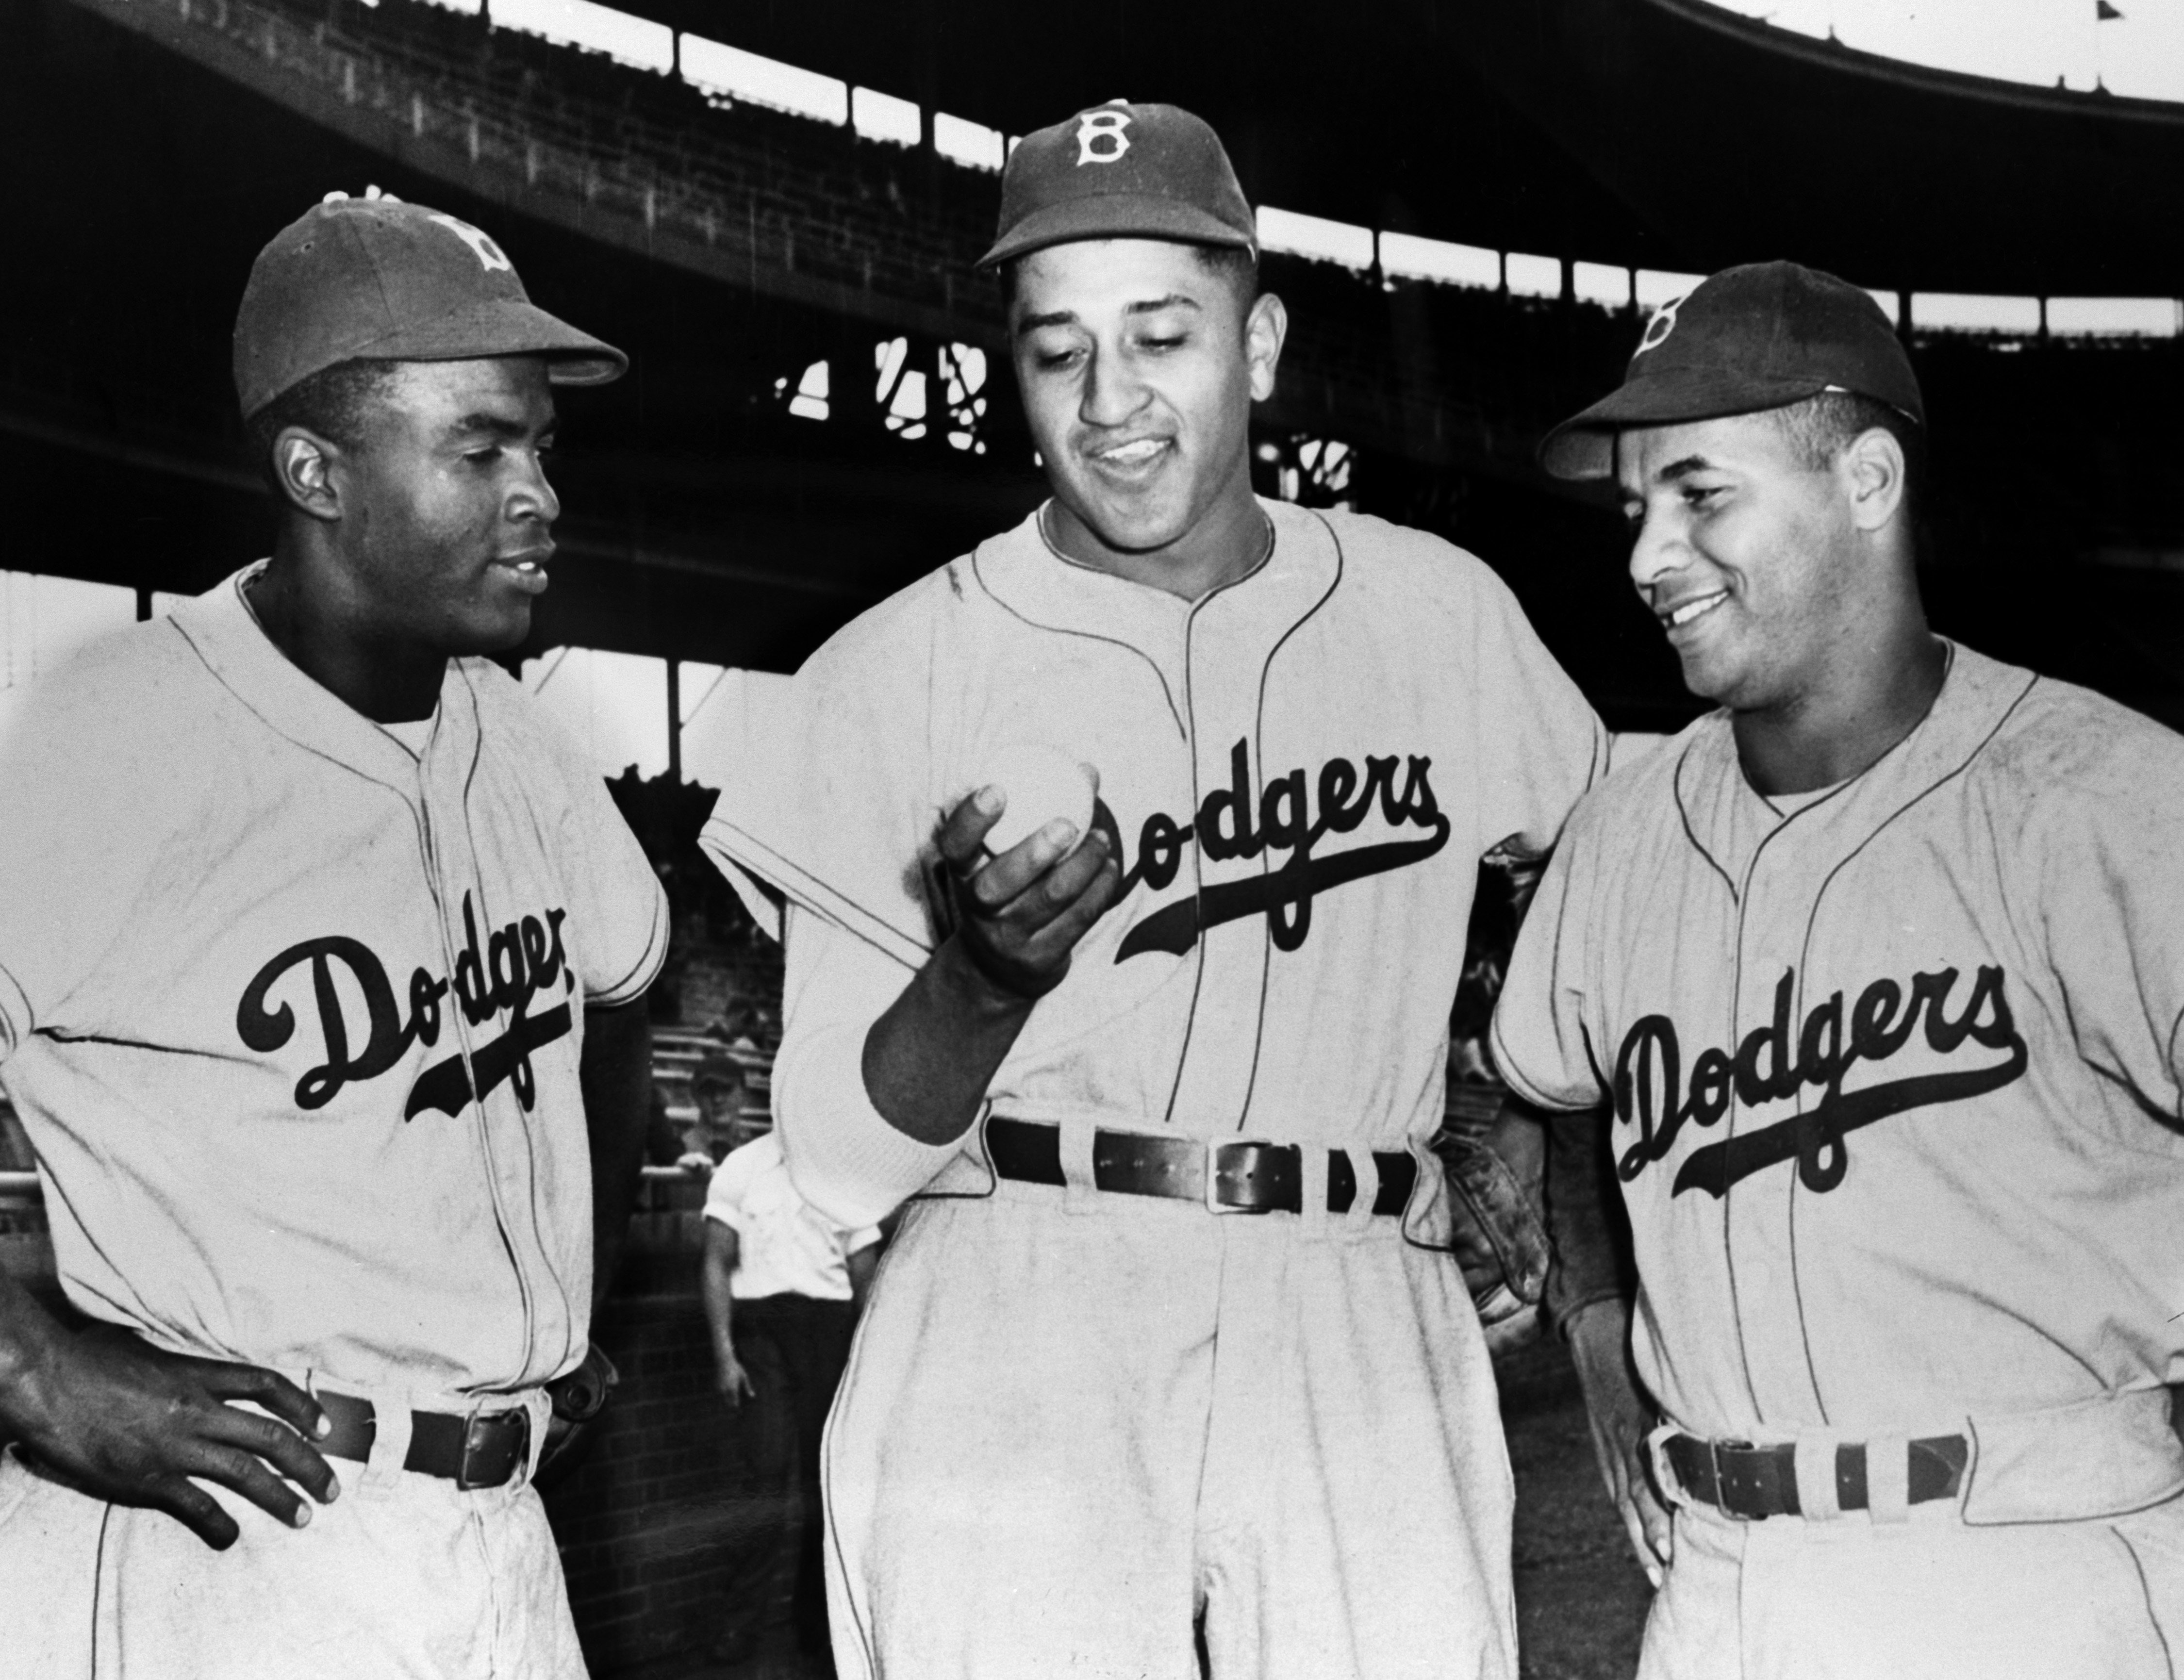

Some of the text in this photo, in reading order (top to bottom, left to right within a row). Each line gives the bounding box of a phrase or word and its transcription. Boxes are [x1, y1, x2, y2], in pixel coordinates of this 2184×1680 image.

[1076, 110, 1132, 167] B
[1093, 736, 1450, 952] odgers
[236, 889, 575, 1112] Dodger
[1614, 965, 2028, 1194] Dodgers
